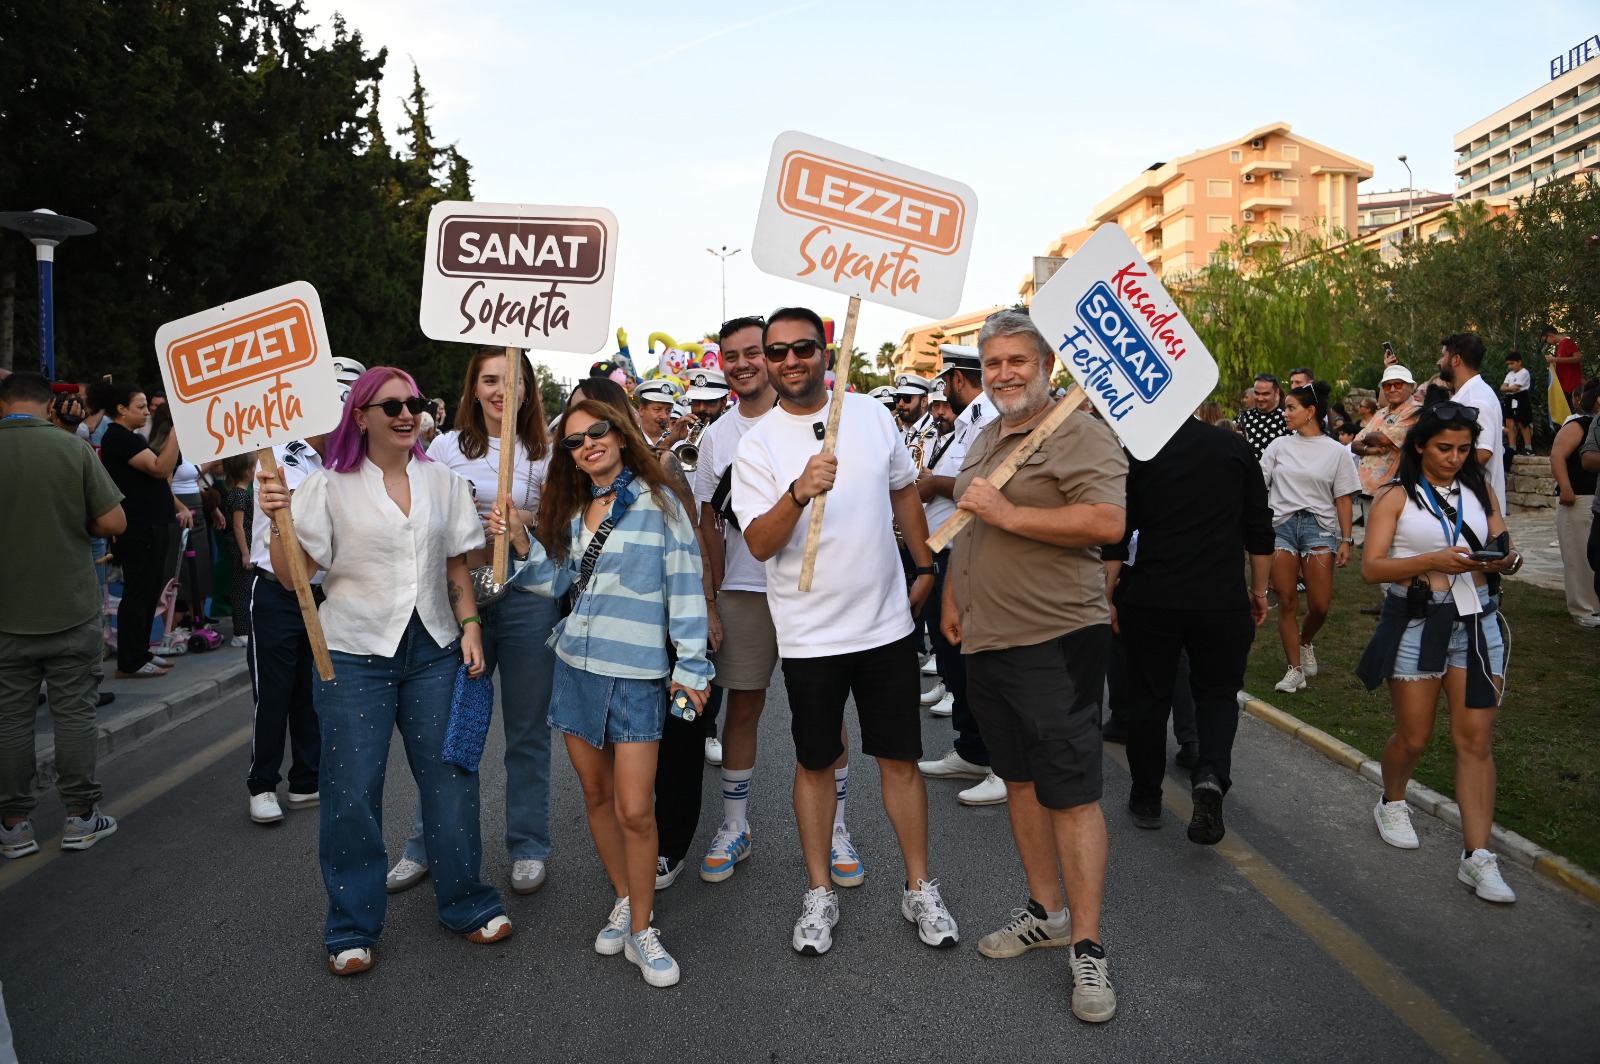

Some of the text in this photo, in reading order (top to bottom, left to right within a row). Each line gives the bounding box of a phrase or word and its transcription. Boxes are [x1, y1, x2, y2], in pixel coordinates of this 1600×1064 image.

[796, 168, 950, 237] LEZZET
[458, 231, 588, 268] SANAT
[797, 225, 921, 297] Sokakta
[459, 280, 570, 337] Sokakta
[1086, 294, 1163, 392] SOKAK
[179, 317, 298, 386] LEZZET
[1059, 325, 1134, 421] Festivali
[206, 374, 303, 455] Sokakta
